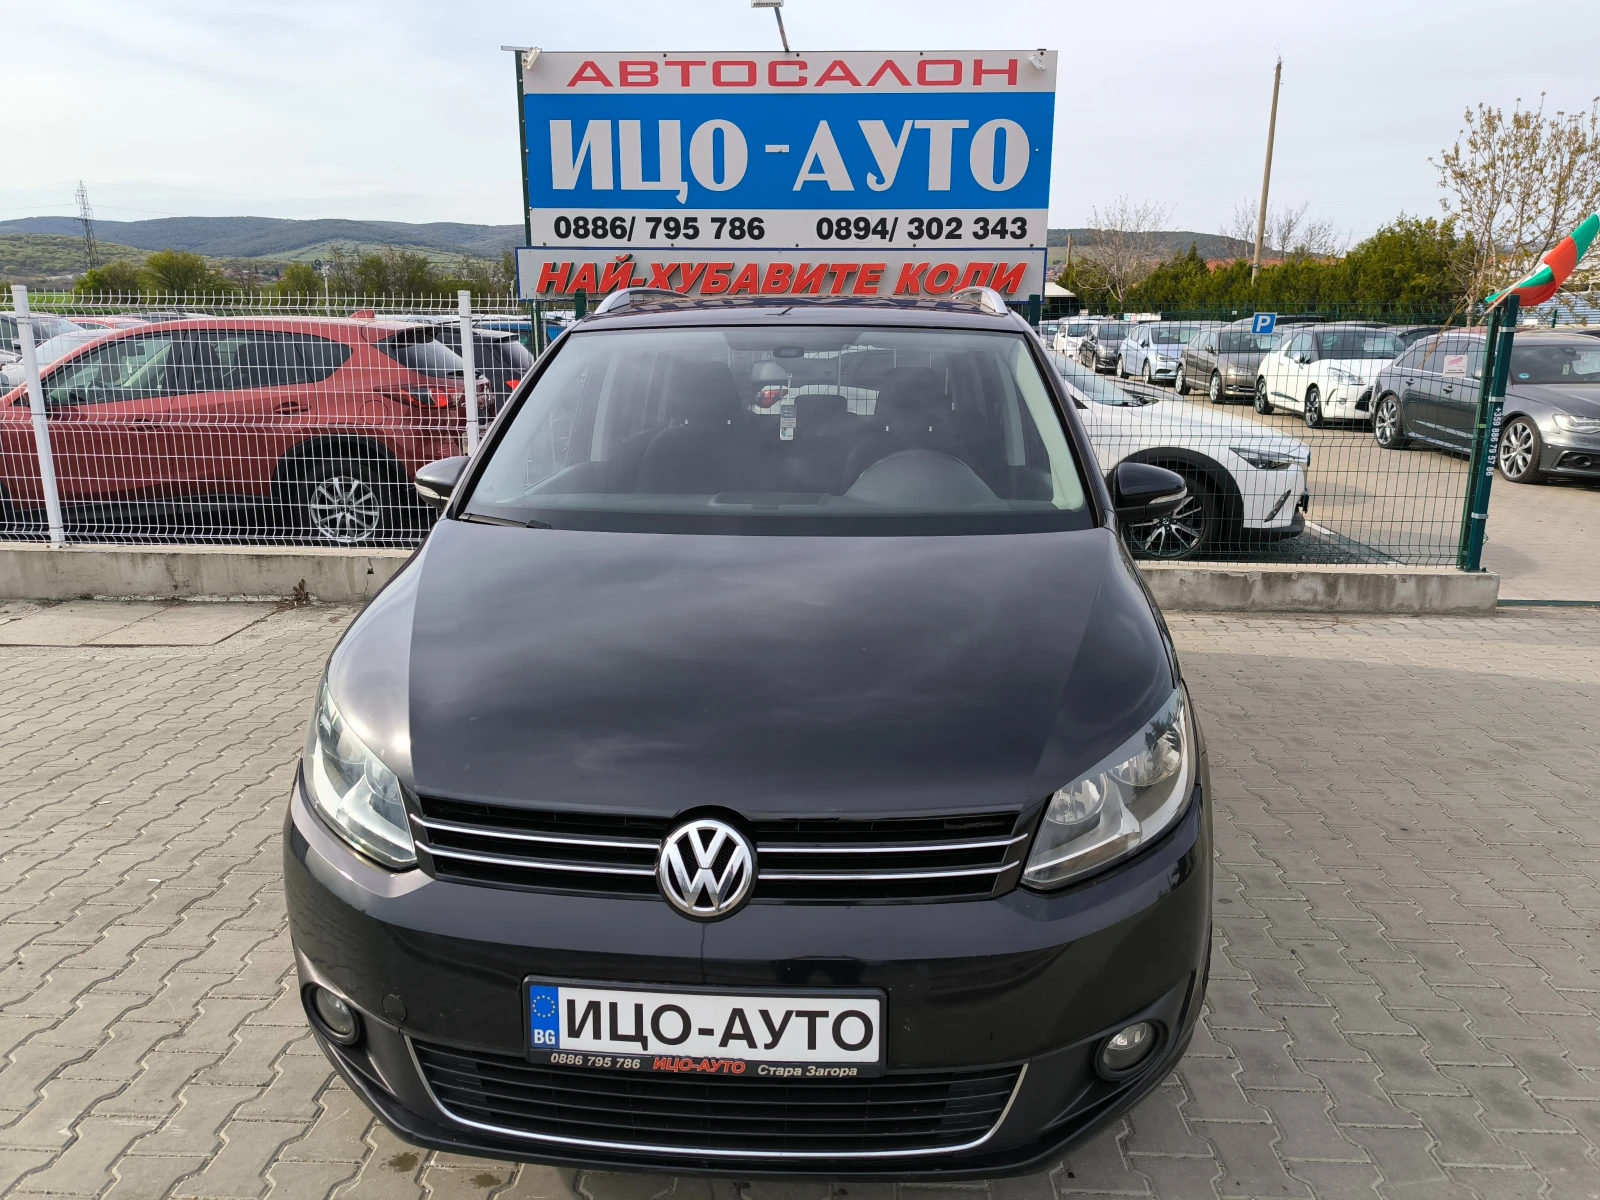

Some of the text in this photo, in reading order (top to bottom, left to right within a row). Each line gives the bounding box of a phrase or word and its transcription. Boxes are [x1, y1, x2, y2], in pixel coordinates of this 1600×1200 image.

[567, 58, 1018, 88] АВТОСАЛОН
[554, 215, 765, 241] 0886/ 795 786
[816, 216, 1028, 241] 0894/ 302 343
[535, 253, 1028, 295] НАЙ-ХУБАВИТЕ КОЛИ
[1256, 316, 1271, 332] P
[566, 998, 874, 1052] ИЦО-АУТО
[533, 1029, 556, 1045] BG
[550, 1053, 641, 1069] 0886 795 786
[653, 1057, 746, 1075] ИЦО-АУТО
[757, 1064, 858, 1077] Стара Загора
